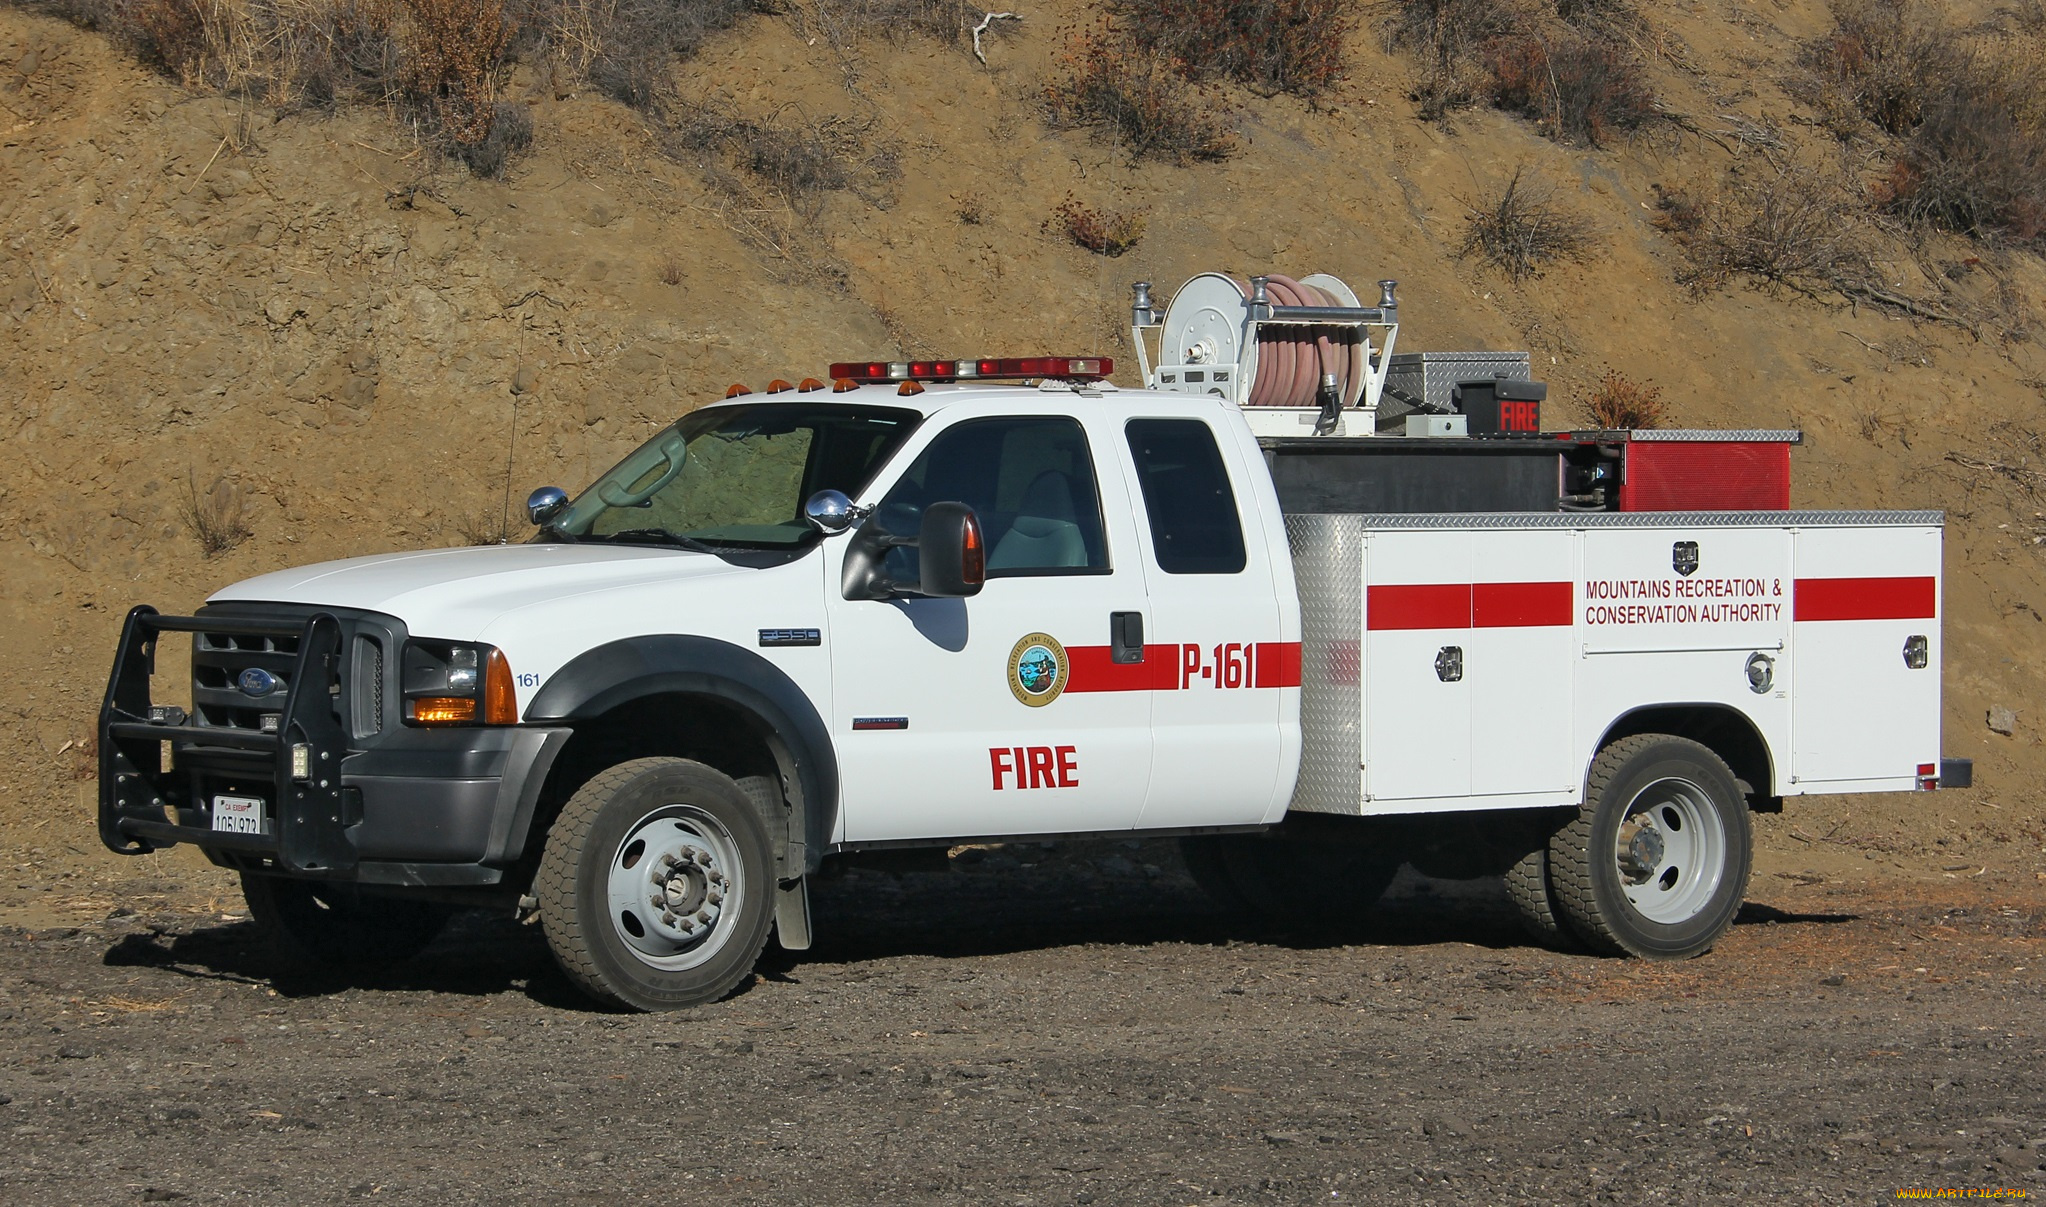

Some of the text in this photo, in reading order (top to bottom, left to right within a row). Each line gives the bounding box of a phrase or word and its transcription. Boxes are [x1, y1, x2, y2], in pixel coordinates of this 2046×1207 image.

[1500, 401, 1538, 431] FIRE
[1586, 578, 1782, 599] MOUNTAINS RECREATION &
[1586, 603, 1782, 625] CONSERVATION AUTHORITY
[1182, 642, 1253, 690] P-161
[516, 673, 540, 688] 161
[988, 745, 1079, 791] FIRE
